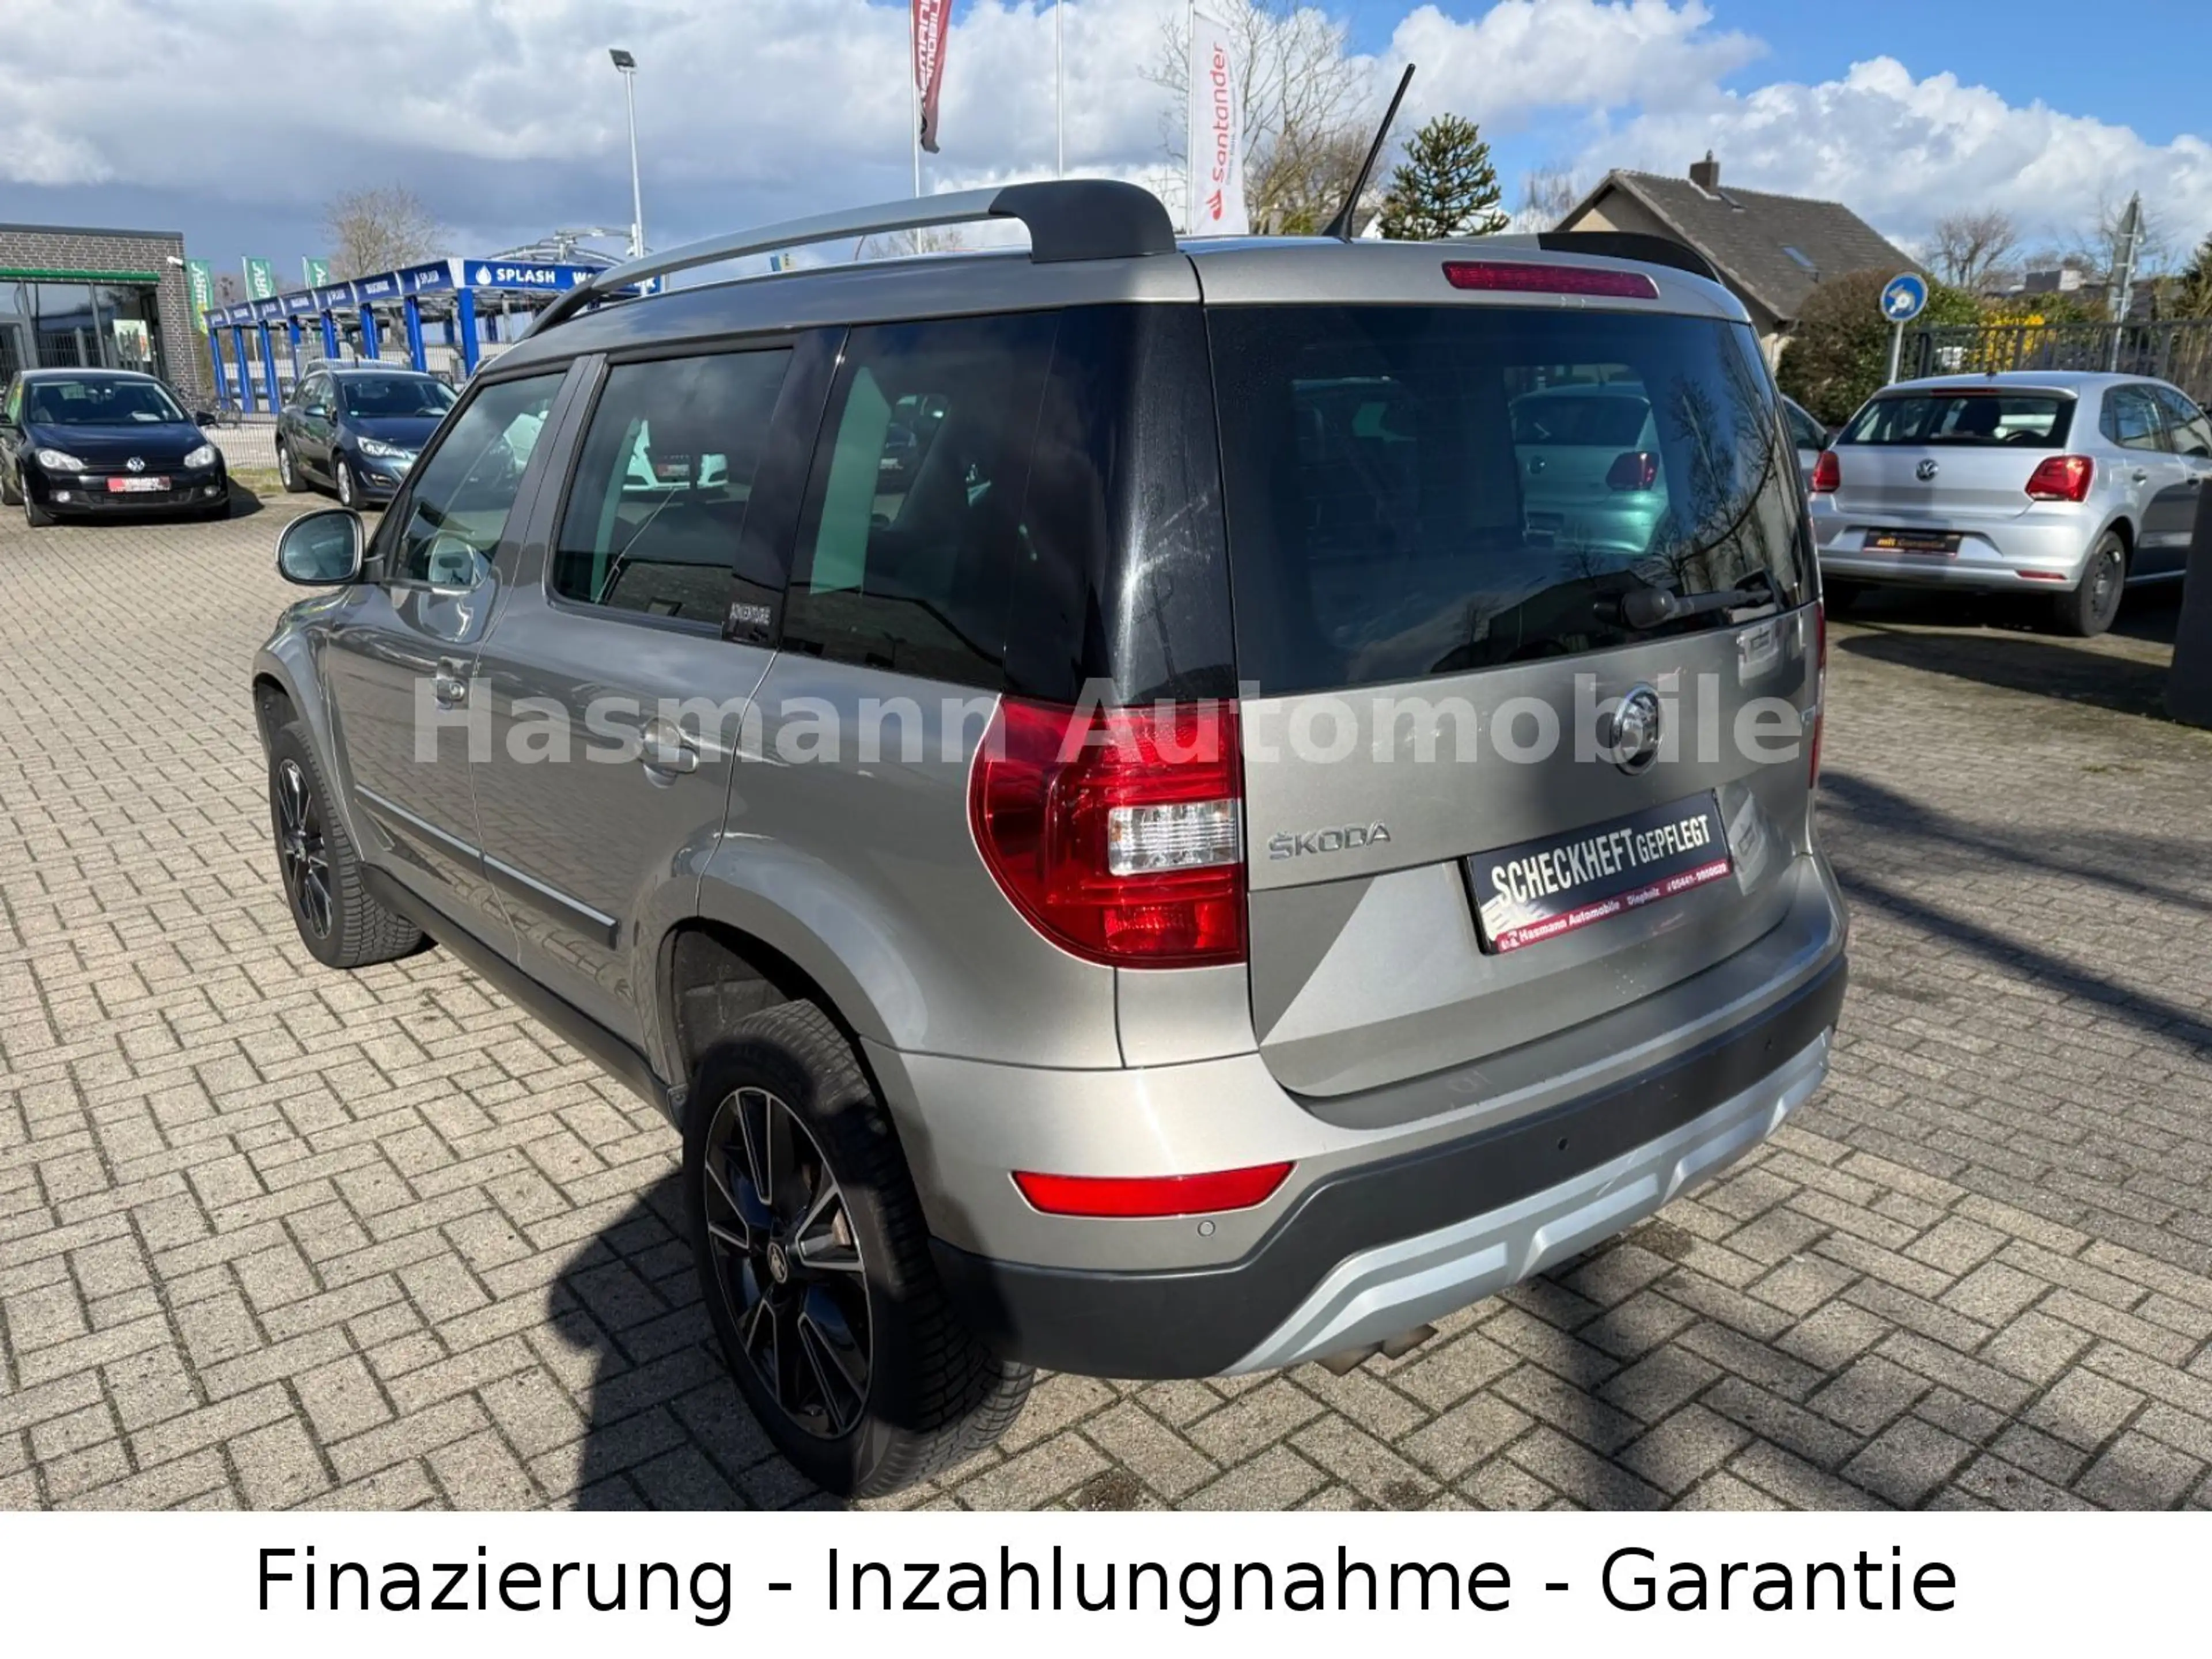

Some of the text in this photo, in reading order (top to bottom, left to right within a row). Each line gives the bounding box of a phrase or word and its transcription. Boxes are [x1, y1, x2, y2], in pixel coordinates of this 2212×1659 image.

[1210, 42, 1229, 183] Santander
[496, 268, 556, 283] SPLASH
[1491, 814, 1711, 907] SCHECKHEFT GEPFLEGT
[1518, 919, 1567, 942] Hasmann
[1569, 900, 1621, 926] Automobile
